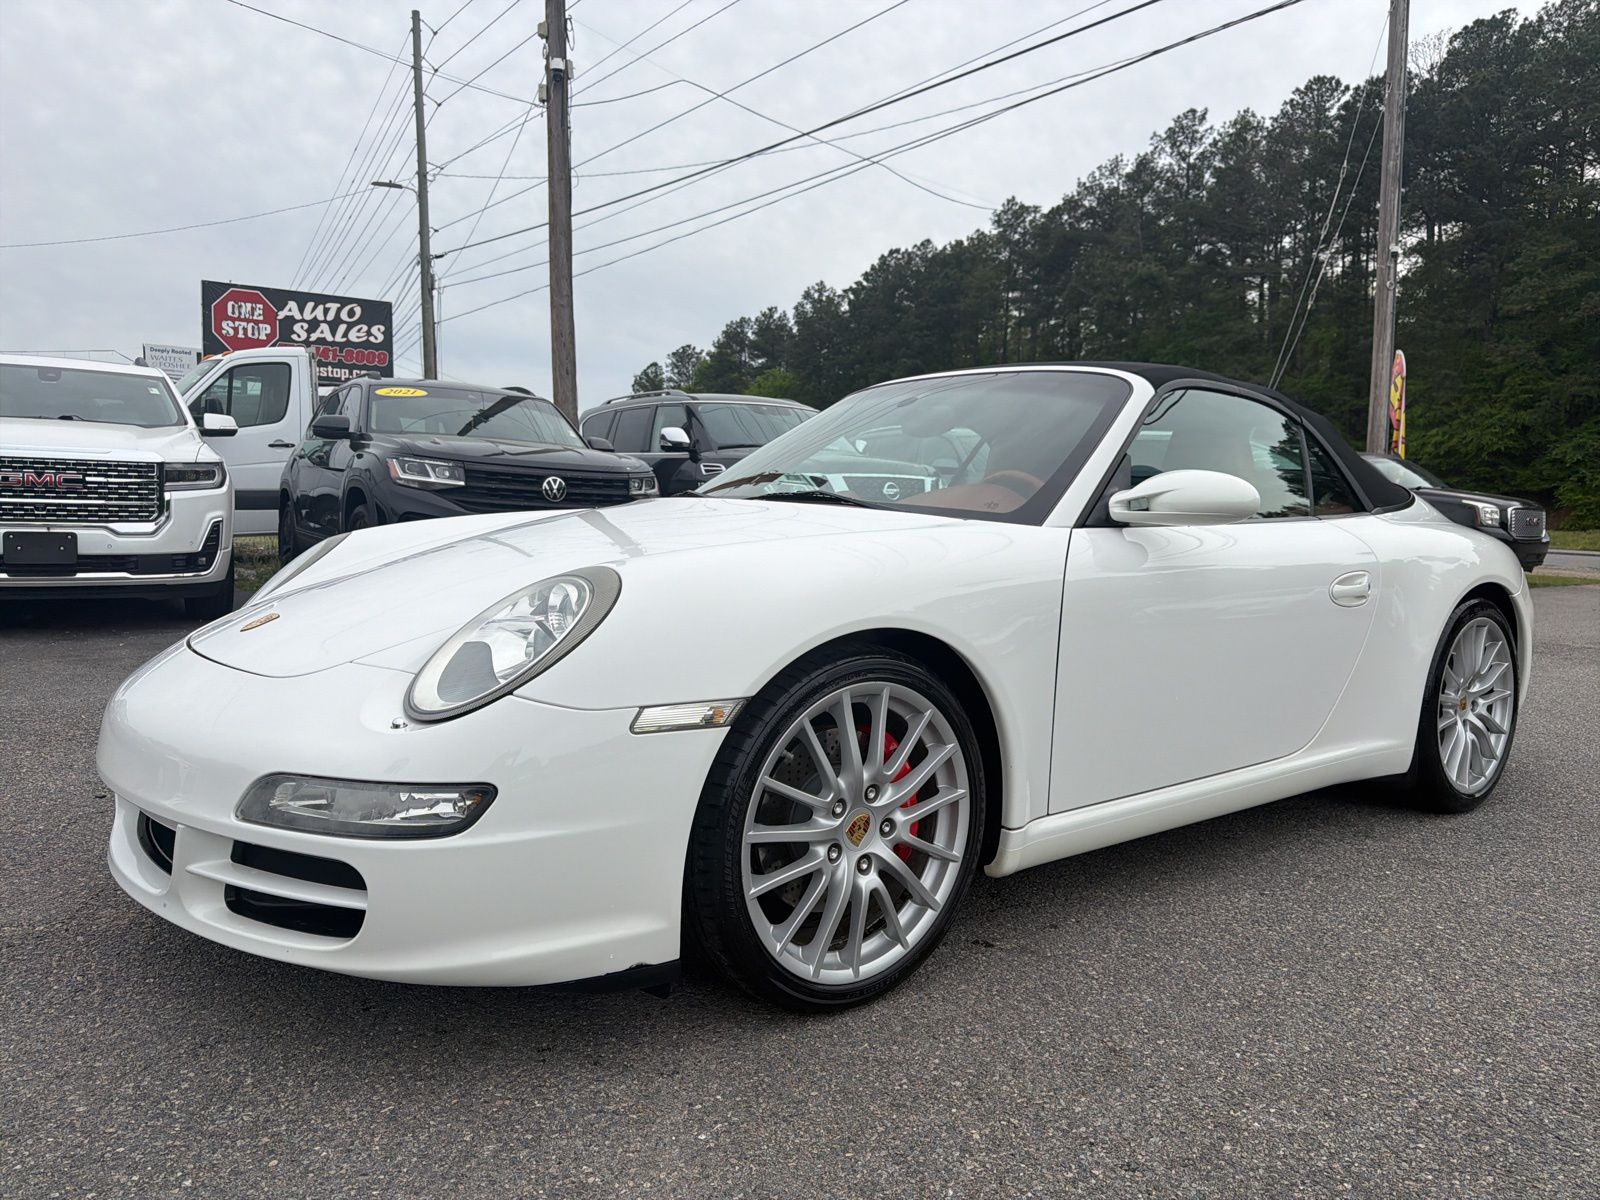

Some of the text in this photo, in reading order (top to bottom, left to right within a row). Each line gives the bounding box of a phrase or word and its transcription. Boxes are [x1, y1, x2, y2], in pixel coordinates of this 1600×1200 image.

[227, 301, 264, 320] ONE
[277, 301, 362, 322] AUTO
[222, 321, 271, 340] STOP
[149, 347, 170, 355] Deeply
[0, 472, 83, 488] GMC
